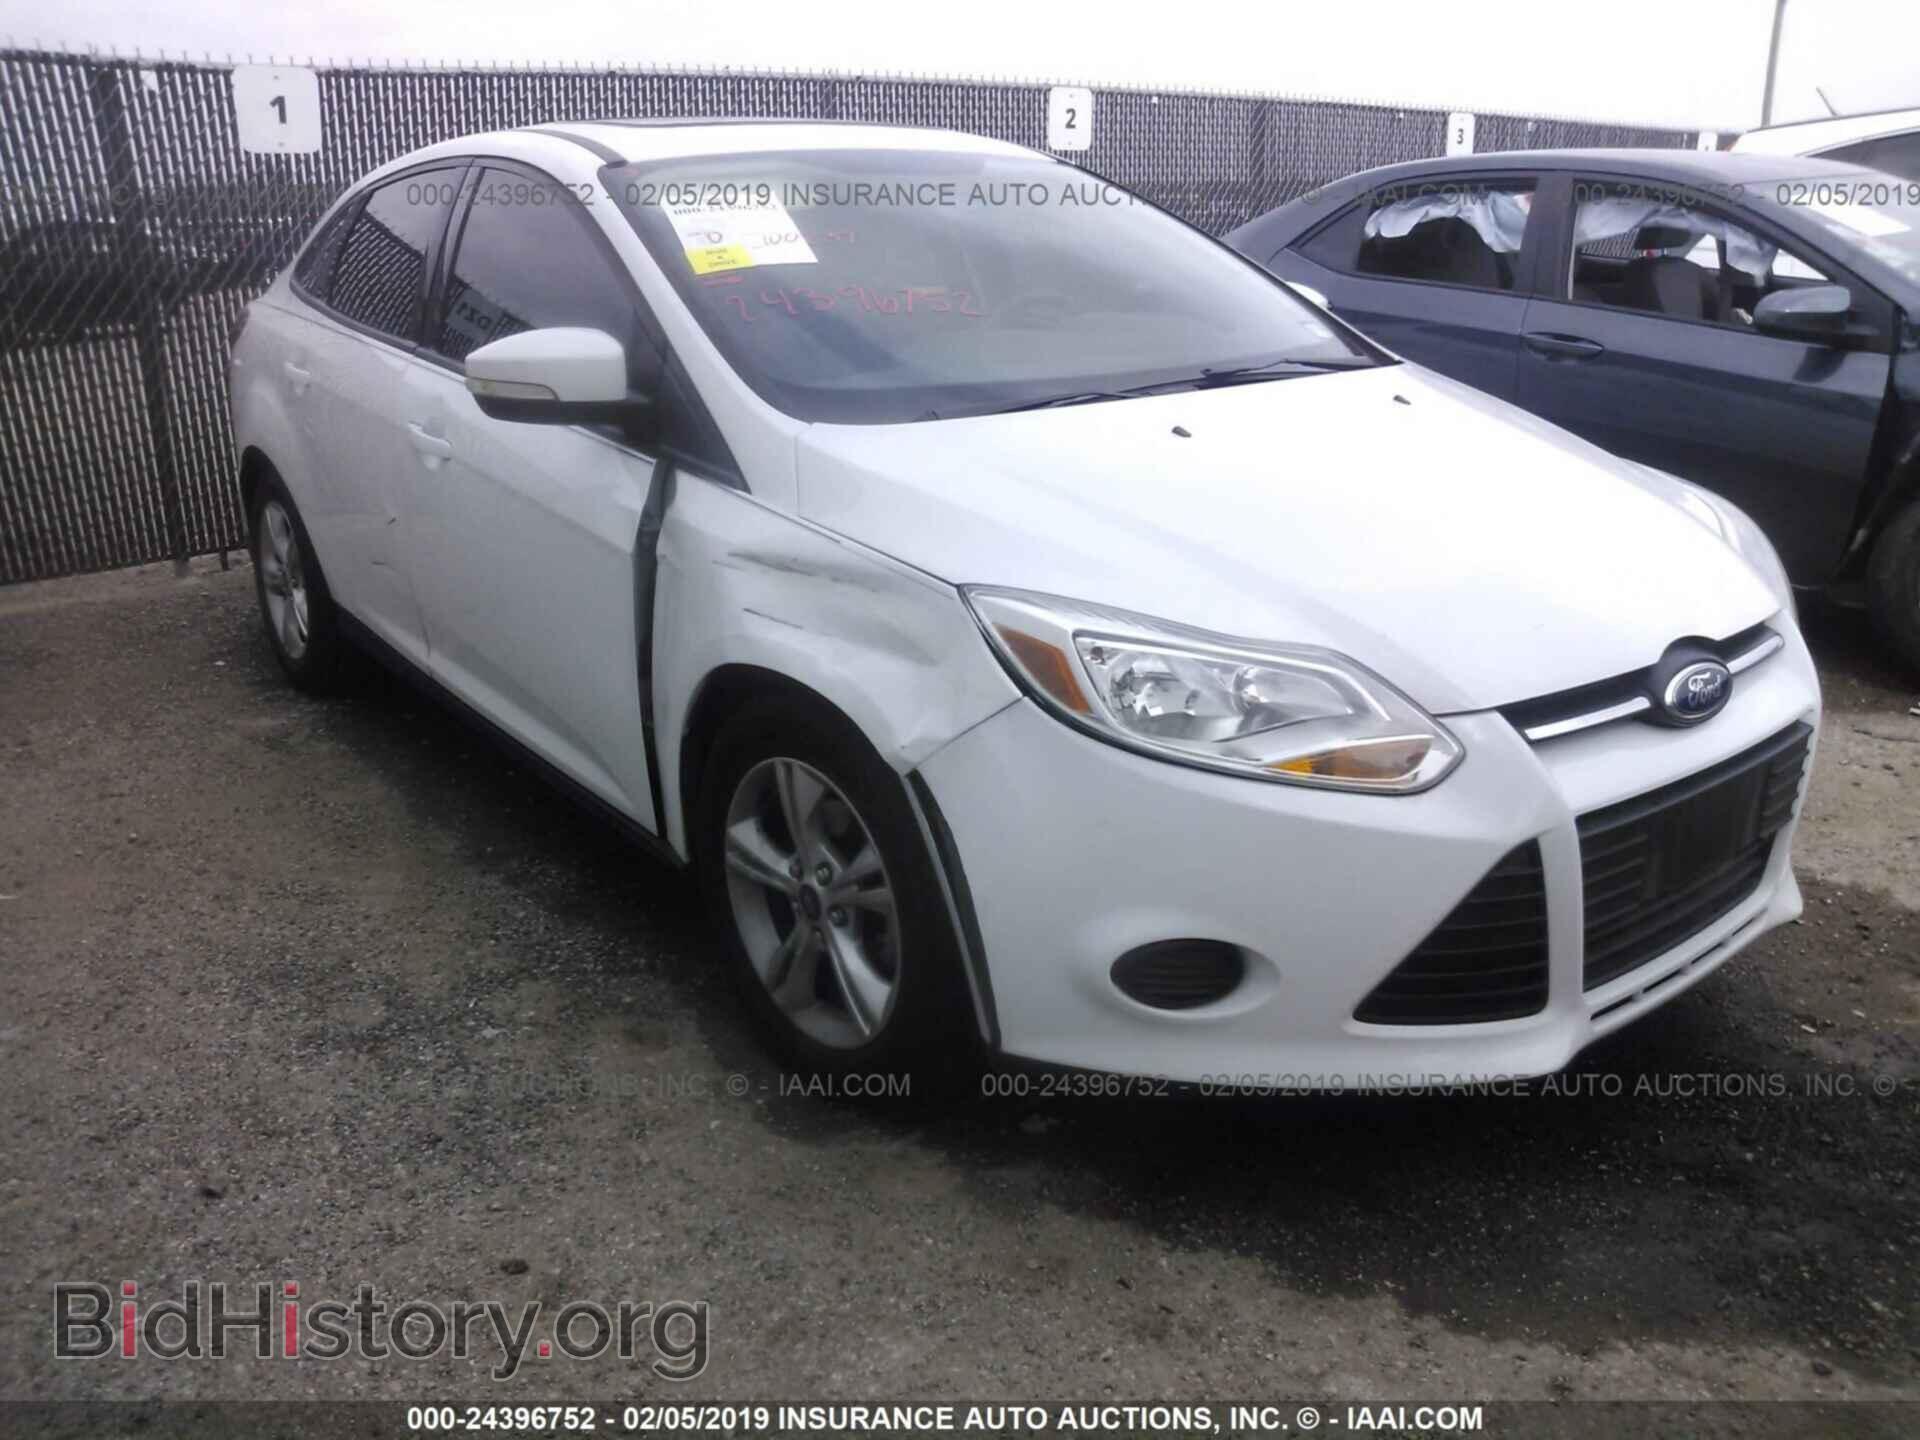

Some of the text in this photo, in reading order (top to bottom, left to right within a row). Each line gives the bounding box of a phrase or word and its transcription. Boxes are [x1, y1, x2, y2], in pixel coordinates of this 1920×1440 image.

[269, 95, 287, 125] 1
[1065, 107, 1077, 129] 2
[1456, 127, 1464, 145] 3
